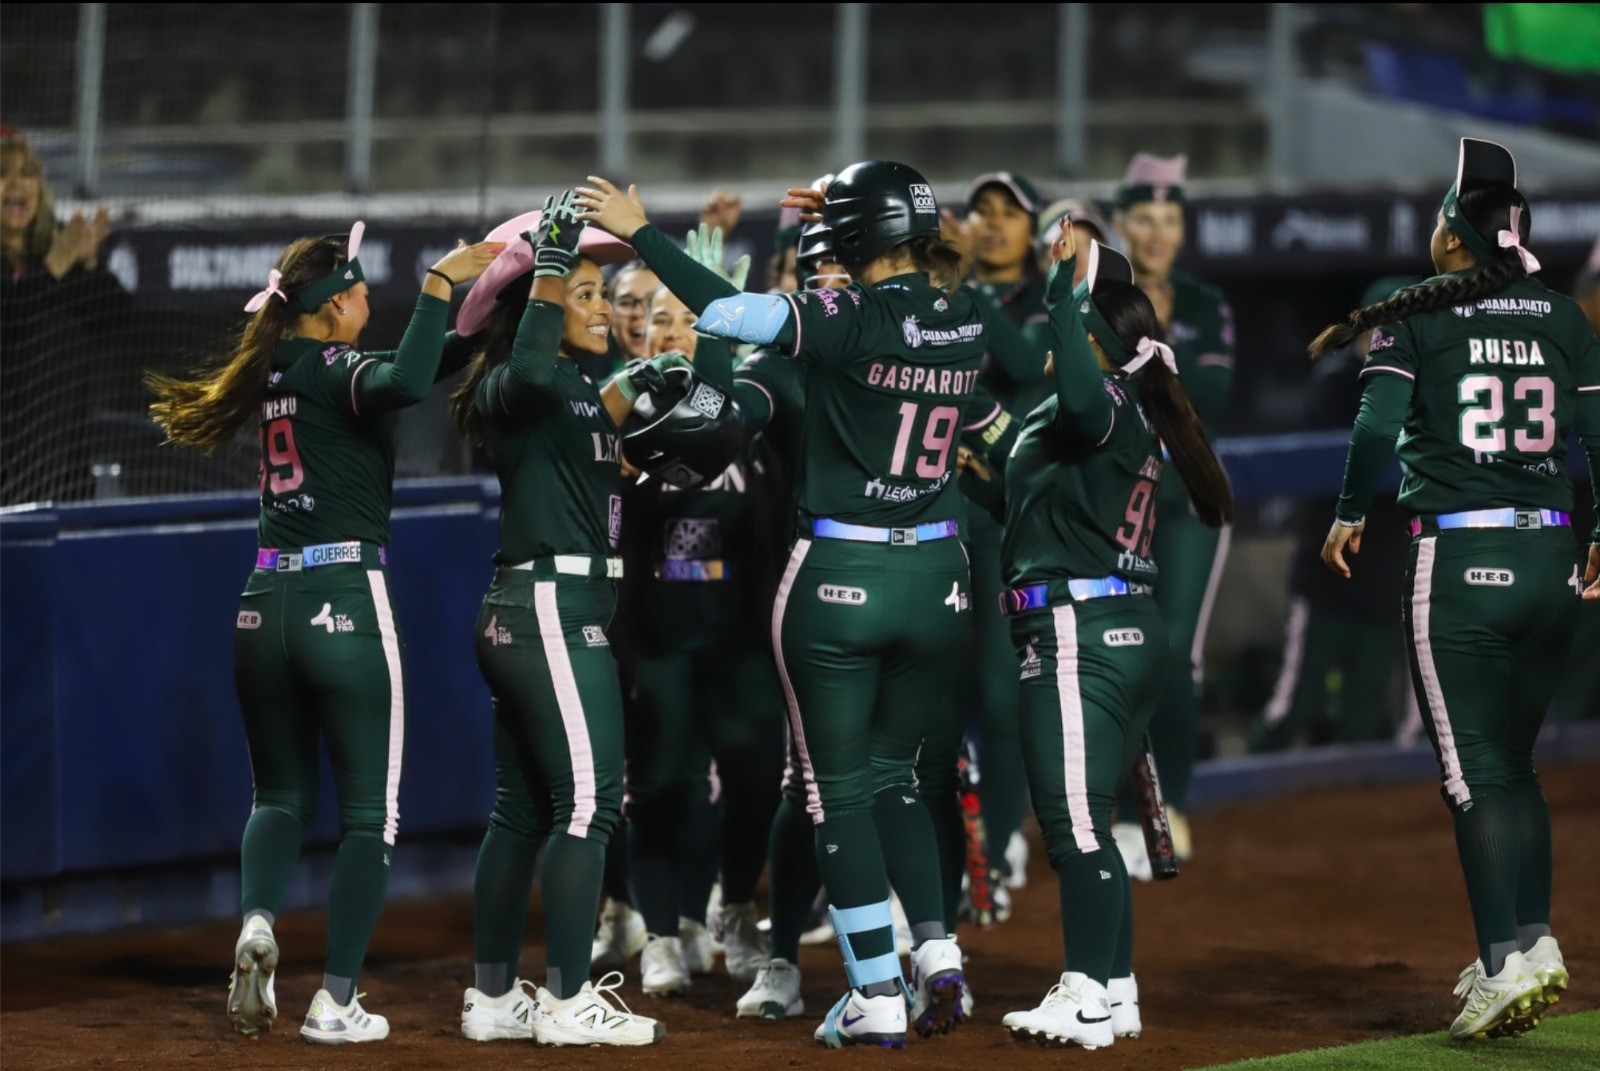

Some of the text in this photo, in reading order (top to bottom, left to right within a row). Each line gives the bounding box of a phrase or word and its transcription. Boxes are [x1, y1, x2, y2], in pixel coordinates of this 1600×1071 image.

[1476, 298, 1552, 314] GUANAJUATO
[1469, 338, 1546, 365] RUEDA
[1458, 373, 1556, 452] 23
[890, 401, 960, 479] 19
